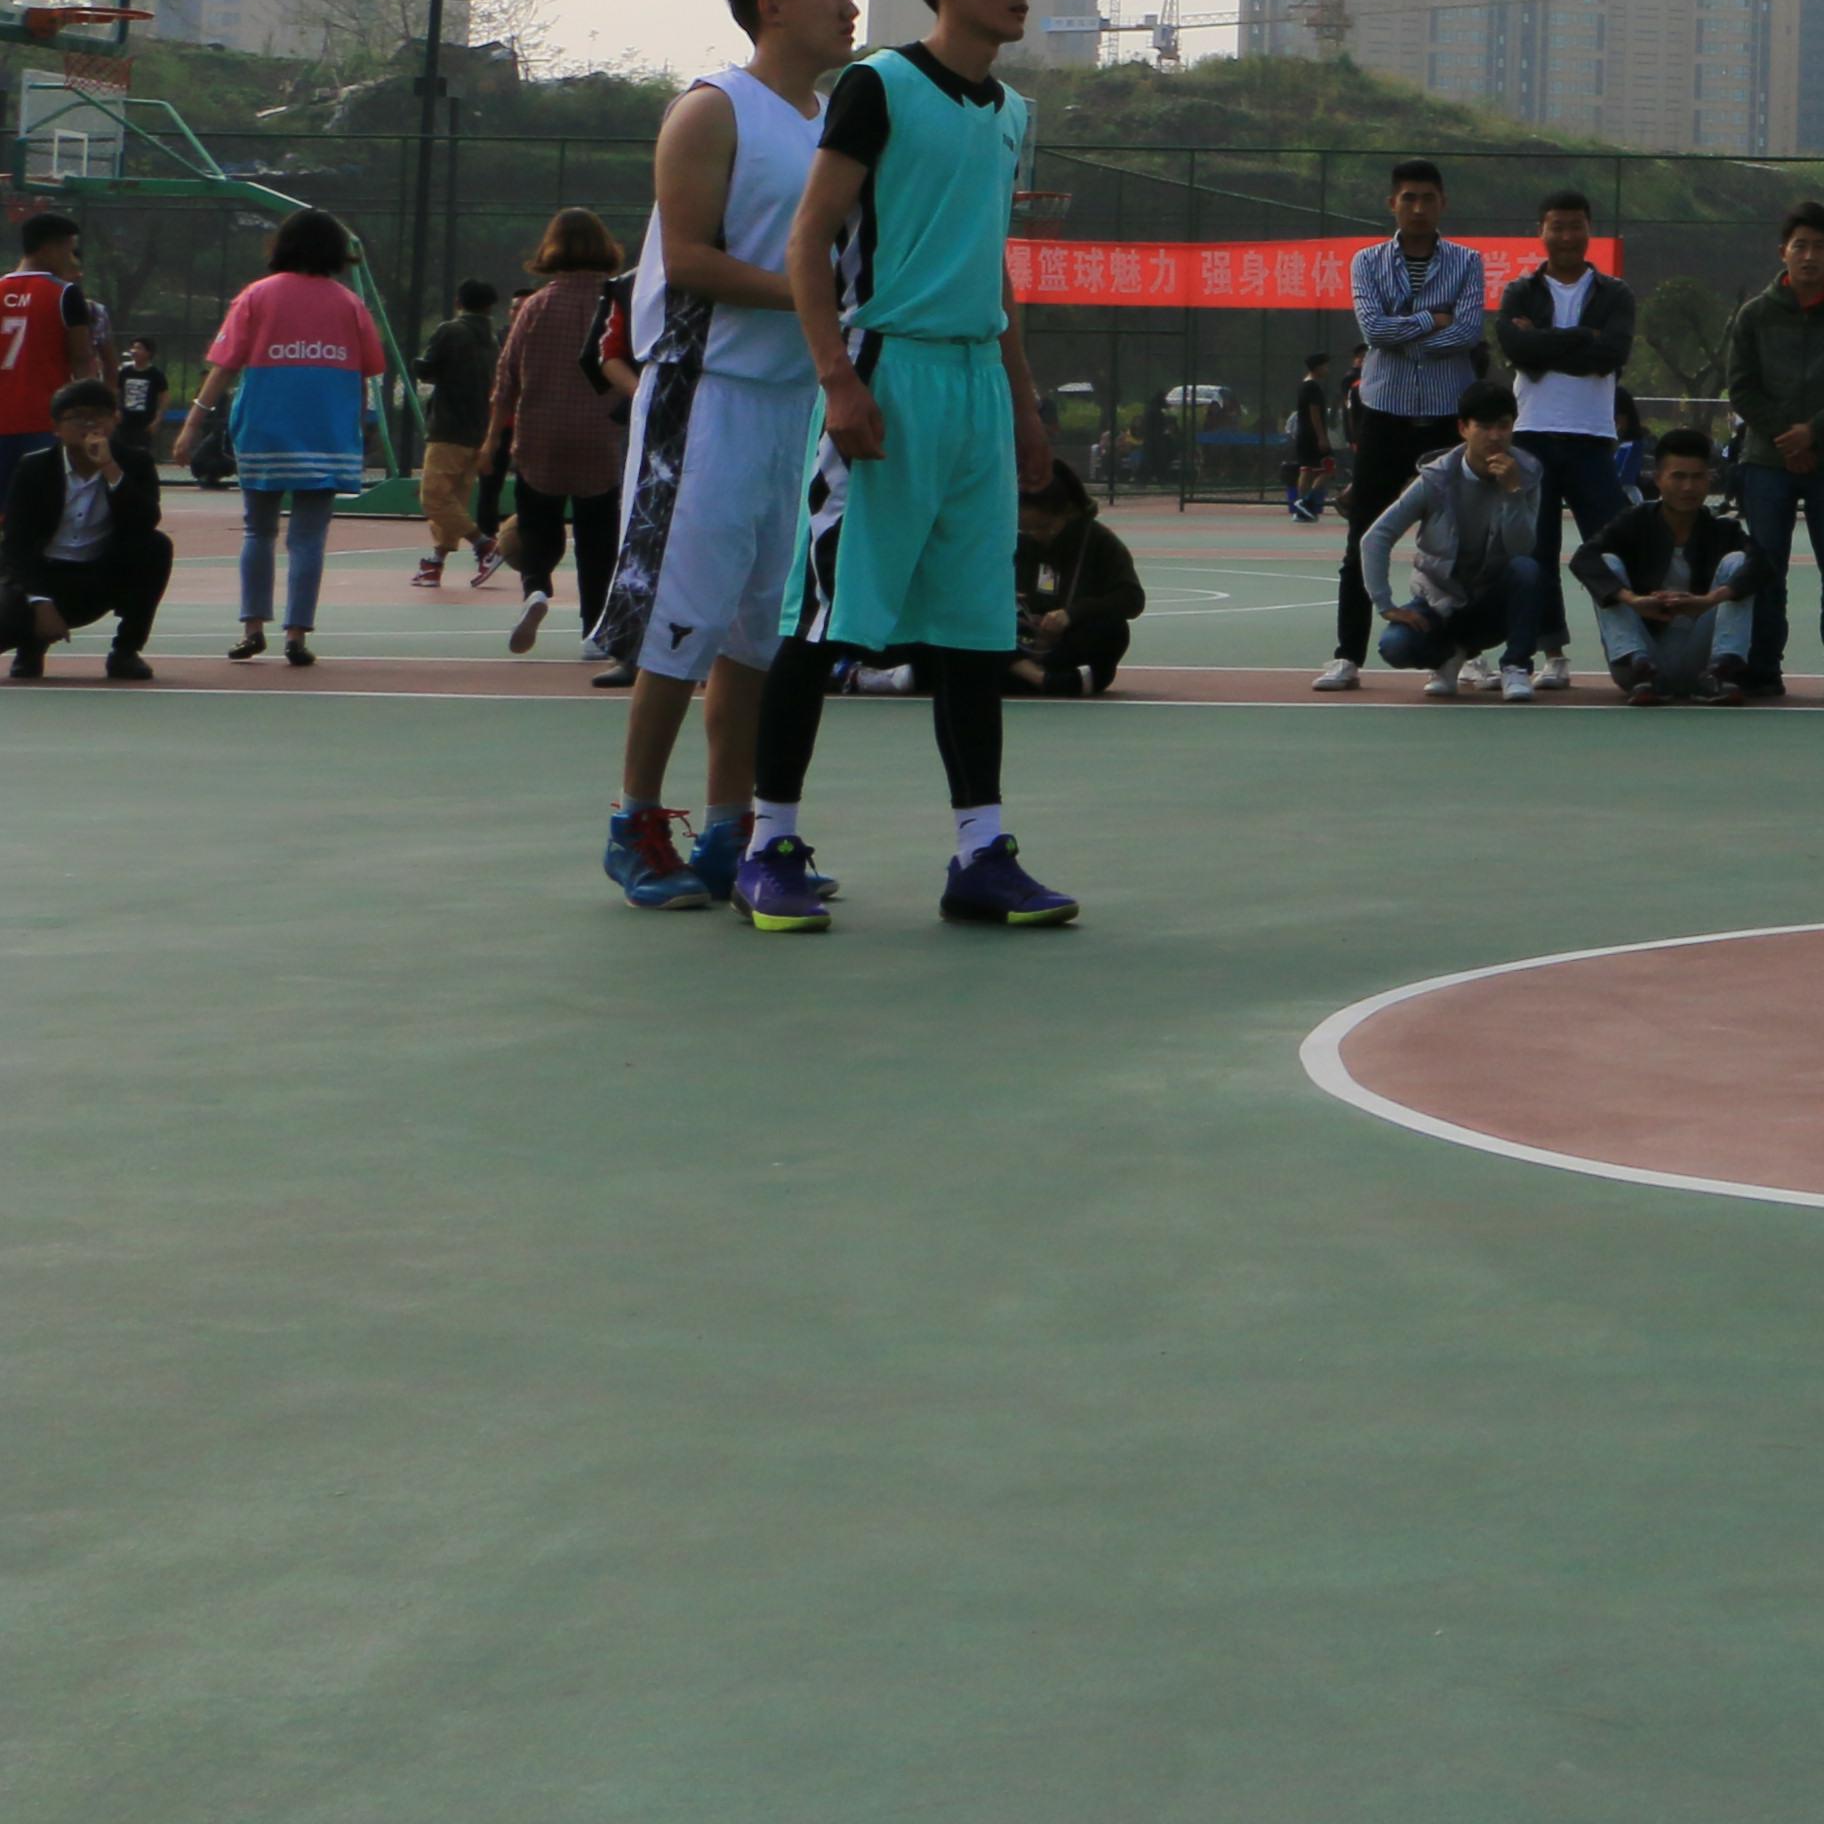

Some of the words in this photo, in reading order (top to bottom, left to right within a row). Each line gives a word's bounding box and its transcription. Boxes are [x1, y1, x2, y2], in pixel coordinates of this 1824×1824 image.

[1201, 250, 1344, 297] 强身健体
[268, 341, 347, 360] adidas
